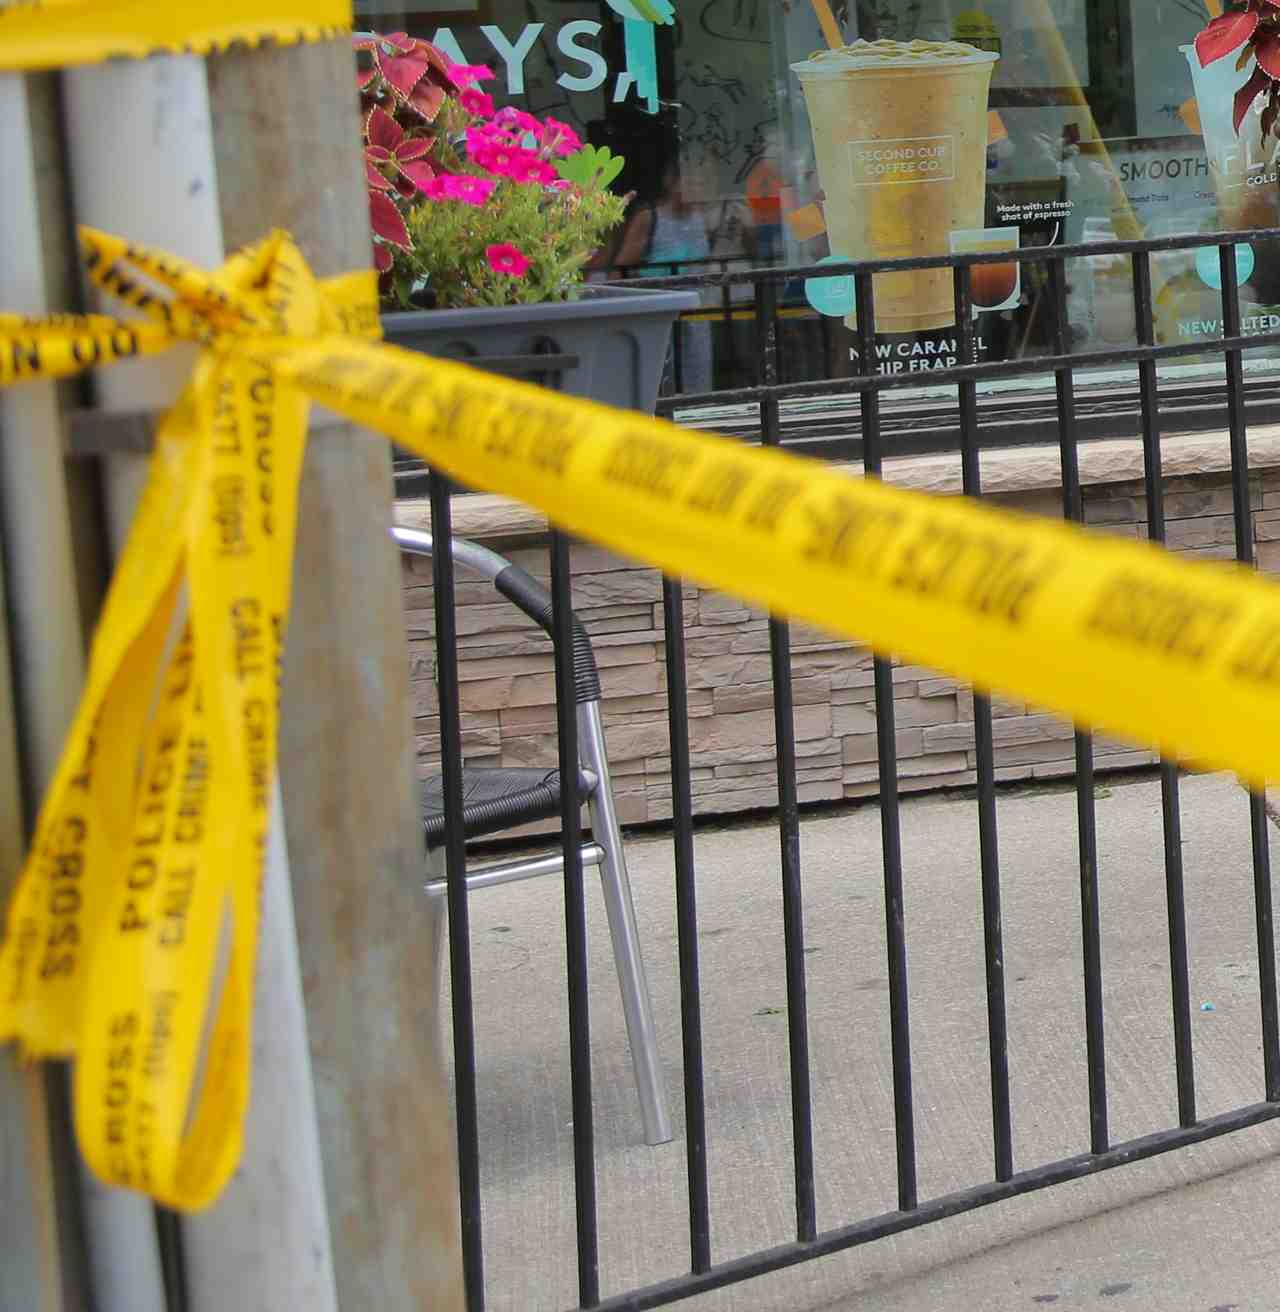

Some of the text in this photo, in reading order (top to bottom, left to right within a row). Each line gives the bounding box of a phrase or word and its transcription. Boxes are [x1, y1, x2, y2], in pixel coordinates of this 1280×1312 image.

[425, 20, 638, 102] AYS,
[1120, 157, 1211, 182] SMOOTH
[1176, 319, 1218, 336] NEW
[849, 336, 988, 361] NW CARAL
[39, 814, 89, 982] CROSS
